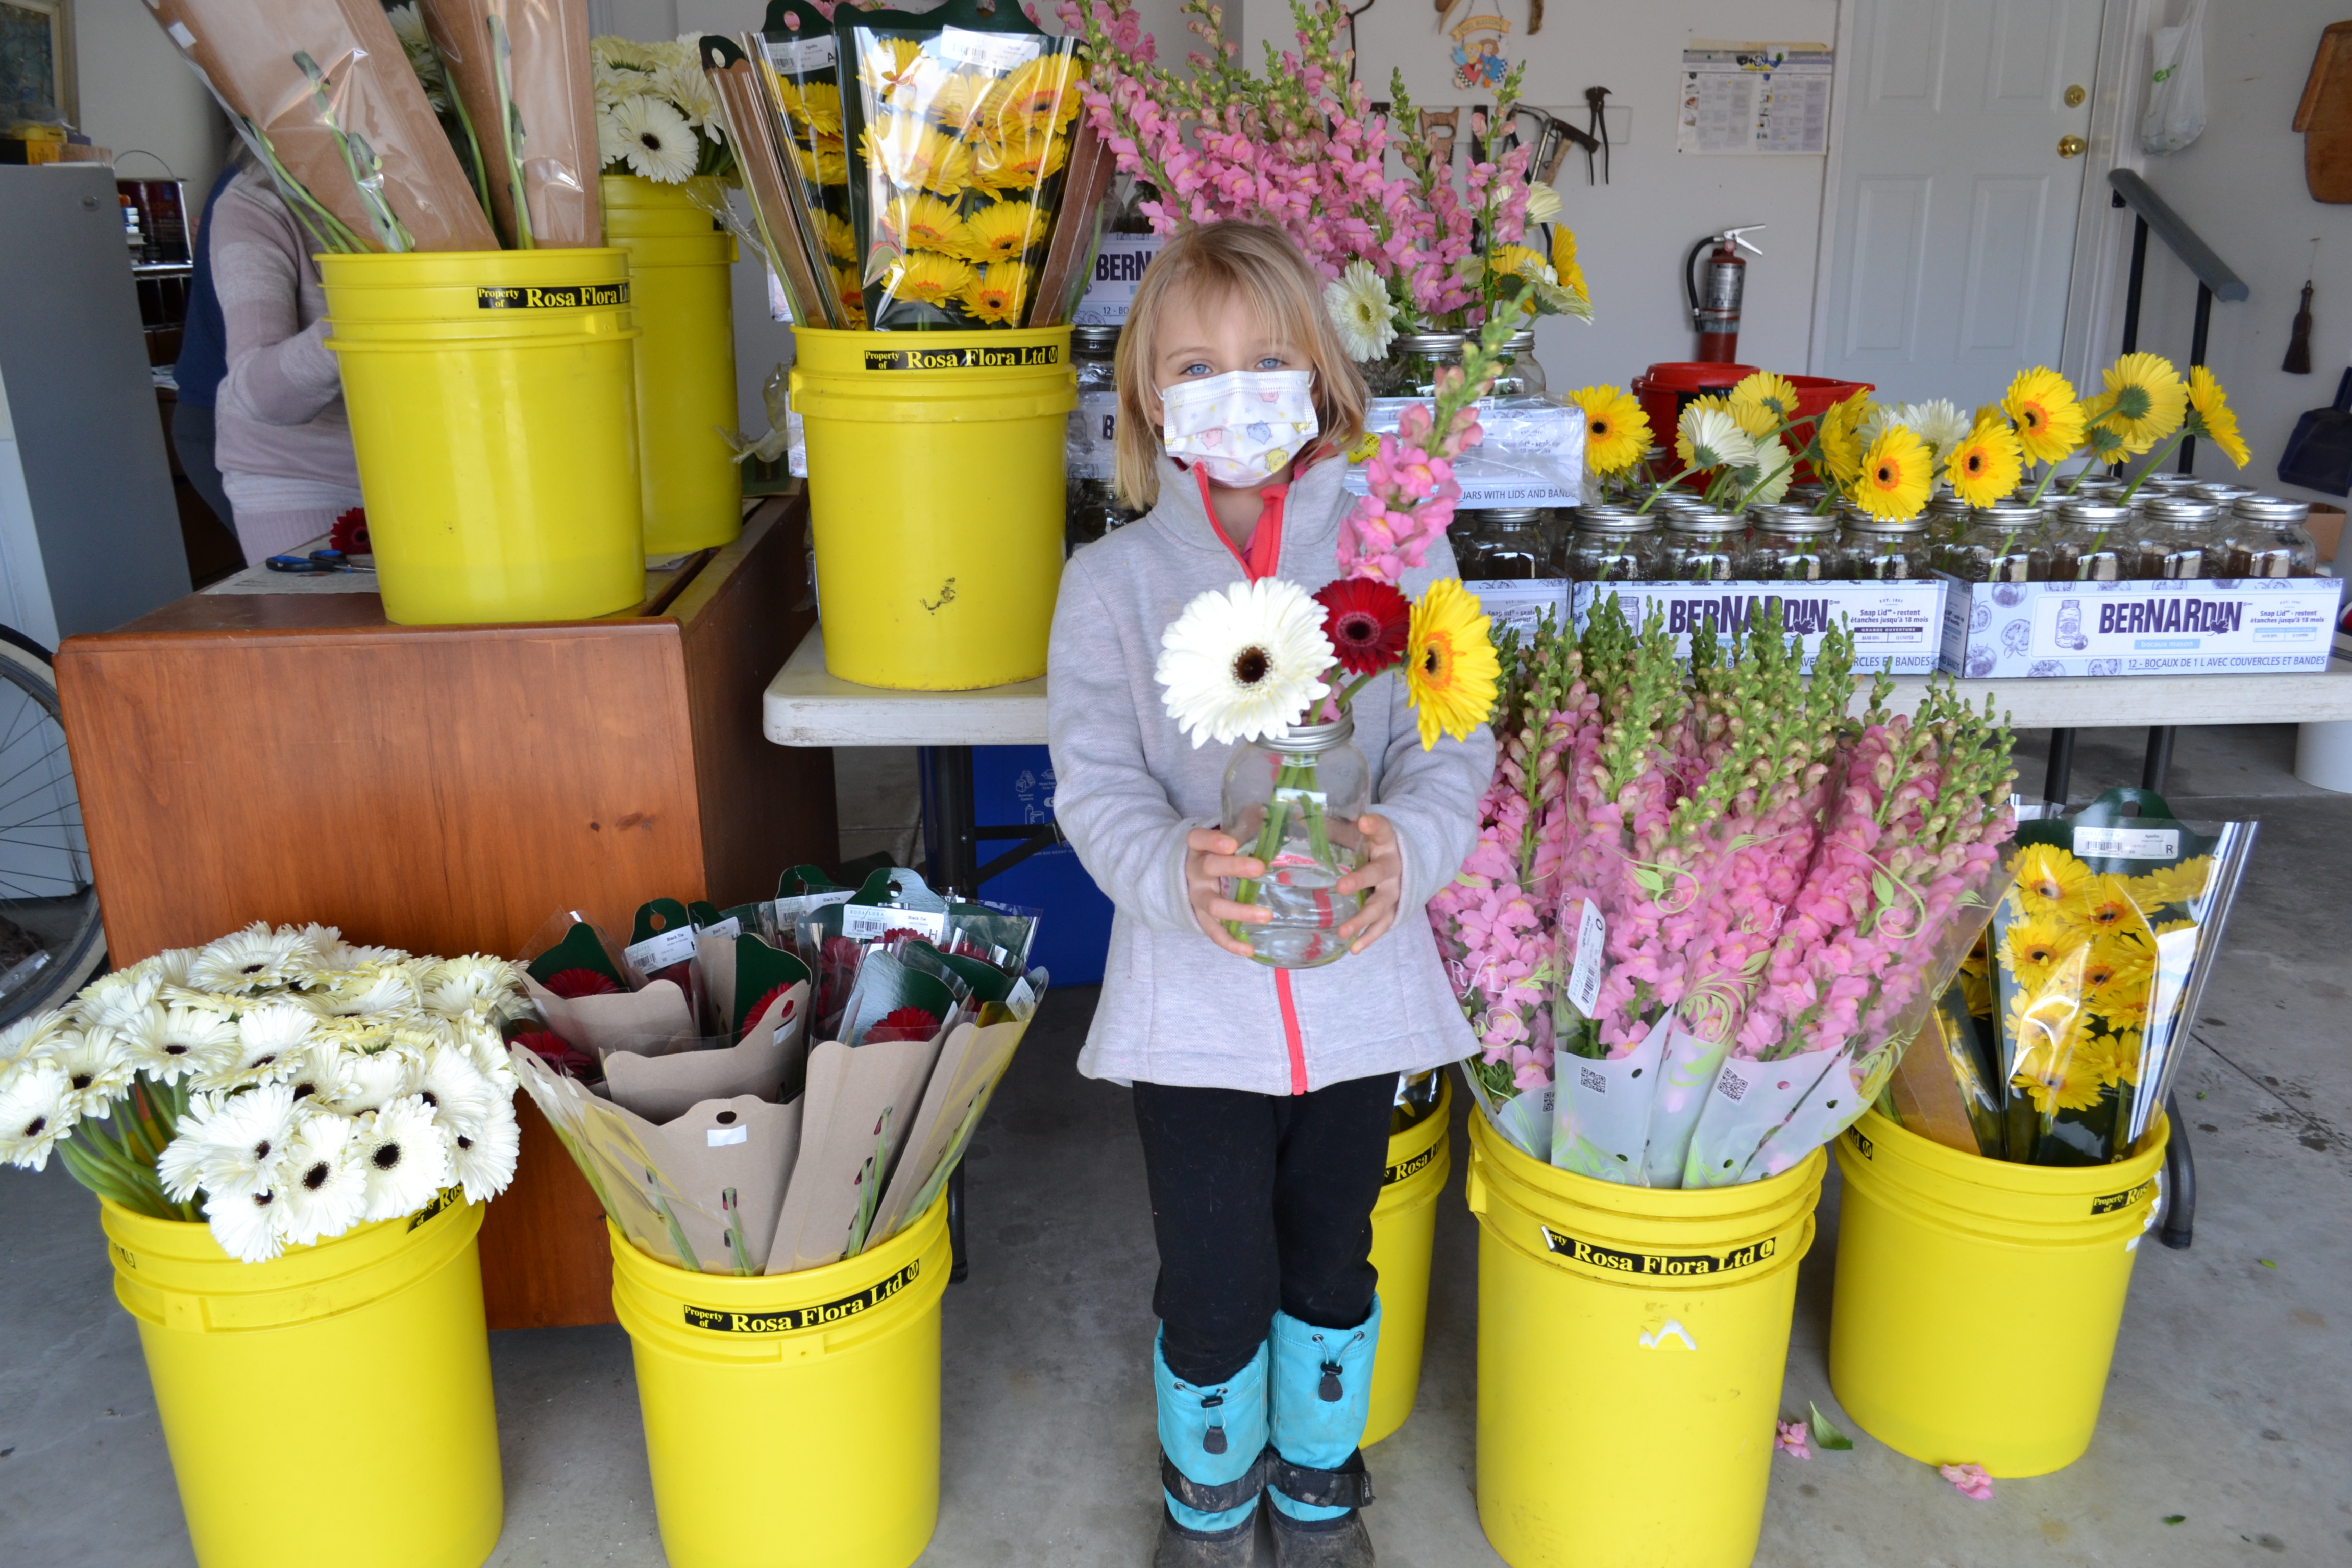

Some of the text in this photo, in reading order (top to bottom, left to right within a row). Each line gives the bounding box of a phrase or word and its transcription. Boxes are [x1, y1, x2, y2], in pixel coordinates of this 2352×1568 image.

[478, 288, 519, 300] Property
[525, 283, 630, 307] Rosa Flora Lt
[495, 299, 505, 308] of
[1103, 307, 1111, 315] 12
[865, 351, 900, 362] Property
[905, 351, 958, 369] Rosa
[964, 349, 1015, 367] Flora
[1021, 348, 1045, 365] Ltd
[879, 361, 887, 369] of
[1463, 491, 1481, 500] JARS
[1484, 491, 1505, 499] WITH
[1508, 490, 1525, 498] LIDS
[1527, 489, 1546, 498] AND
[2099, 599, 2243, 635] BERNARDIN
[1801, 657, 1817, 666] AVE
[1883, 657, 1891, 666] E
[1896, 656, 1930, 666] BANDES
[2129, 659, 2137, 668] 12
[2145, 659, 2178, 667] BOCAUX
[2207, 658, 2228, 666] AVEC
[2230, 657, 2280, 666] COUVERCLES
[2294, 656, 2325, 665] BANDES
[2166, 845, 2173, 854] R
[929, 929, 938, 940] H
[1394, 1154, 1428, 1181] Rosa
[439, 1184, 463, 1212] Ros
[2094, 1194, 2124, 1206] Property
[2125, 1187, 2148, 1206] Ros
[417, 1214, 425, 1226] of
[1573, 1240, 1633, 1271] Rosa
[1641, 1255, 1709, 1275] Flora
[1717, 1246, 1755, 1271] Ltd
[729, 1314, 793, 1332] Rosa
[799, 1299, 864, 1327] Flora
[869, 1272, 903, 1306] Ltd
[684, 1305, 723, 1322] Property
[699, 1319, 709, 1328] of
